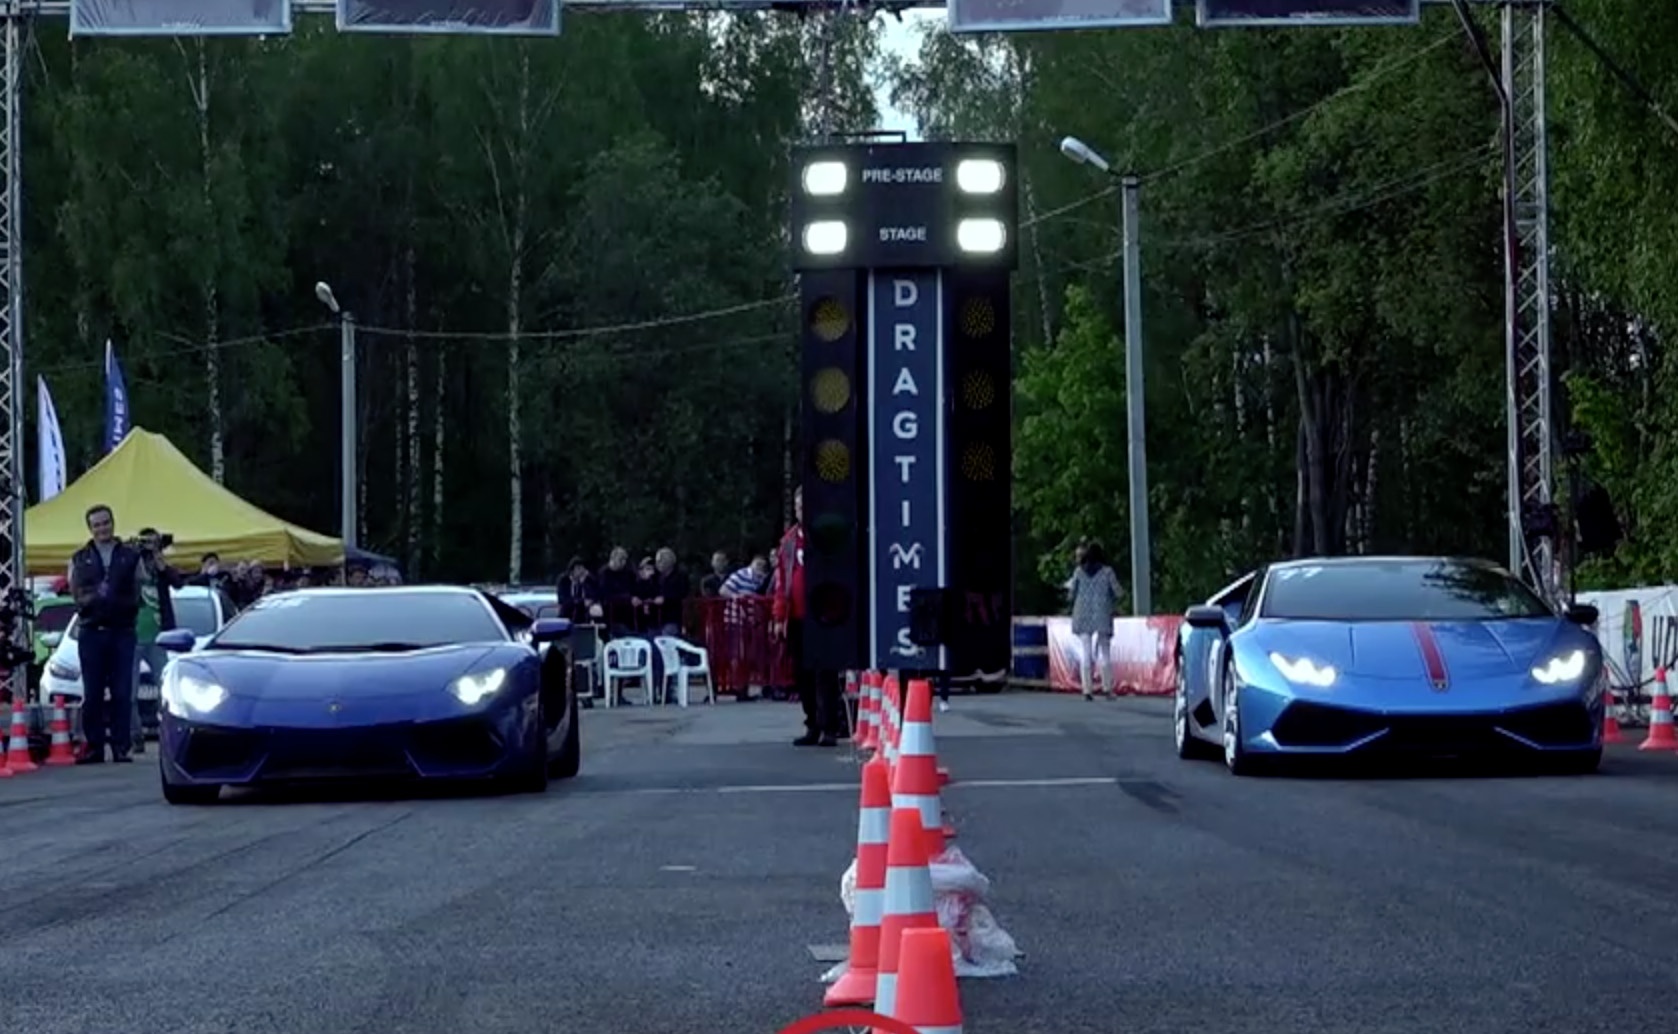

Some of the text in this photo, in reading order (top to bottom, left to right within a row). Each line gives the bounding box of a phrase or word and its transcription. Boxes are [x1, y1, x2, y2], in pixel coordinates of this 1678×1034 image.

[862, 167, 943, 183] PRE-STAGE
[879, 227, 927, 241] STAGE
[891, 279, 922, 657] DRAGTIMES
